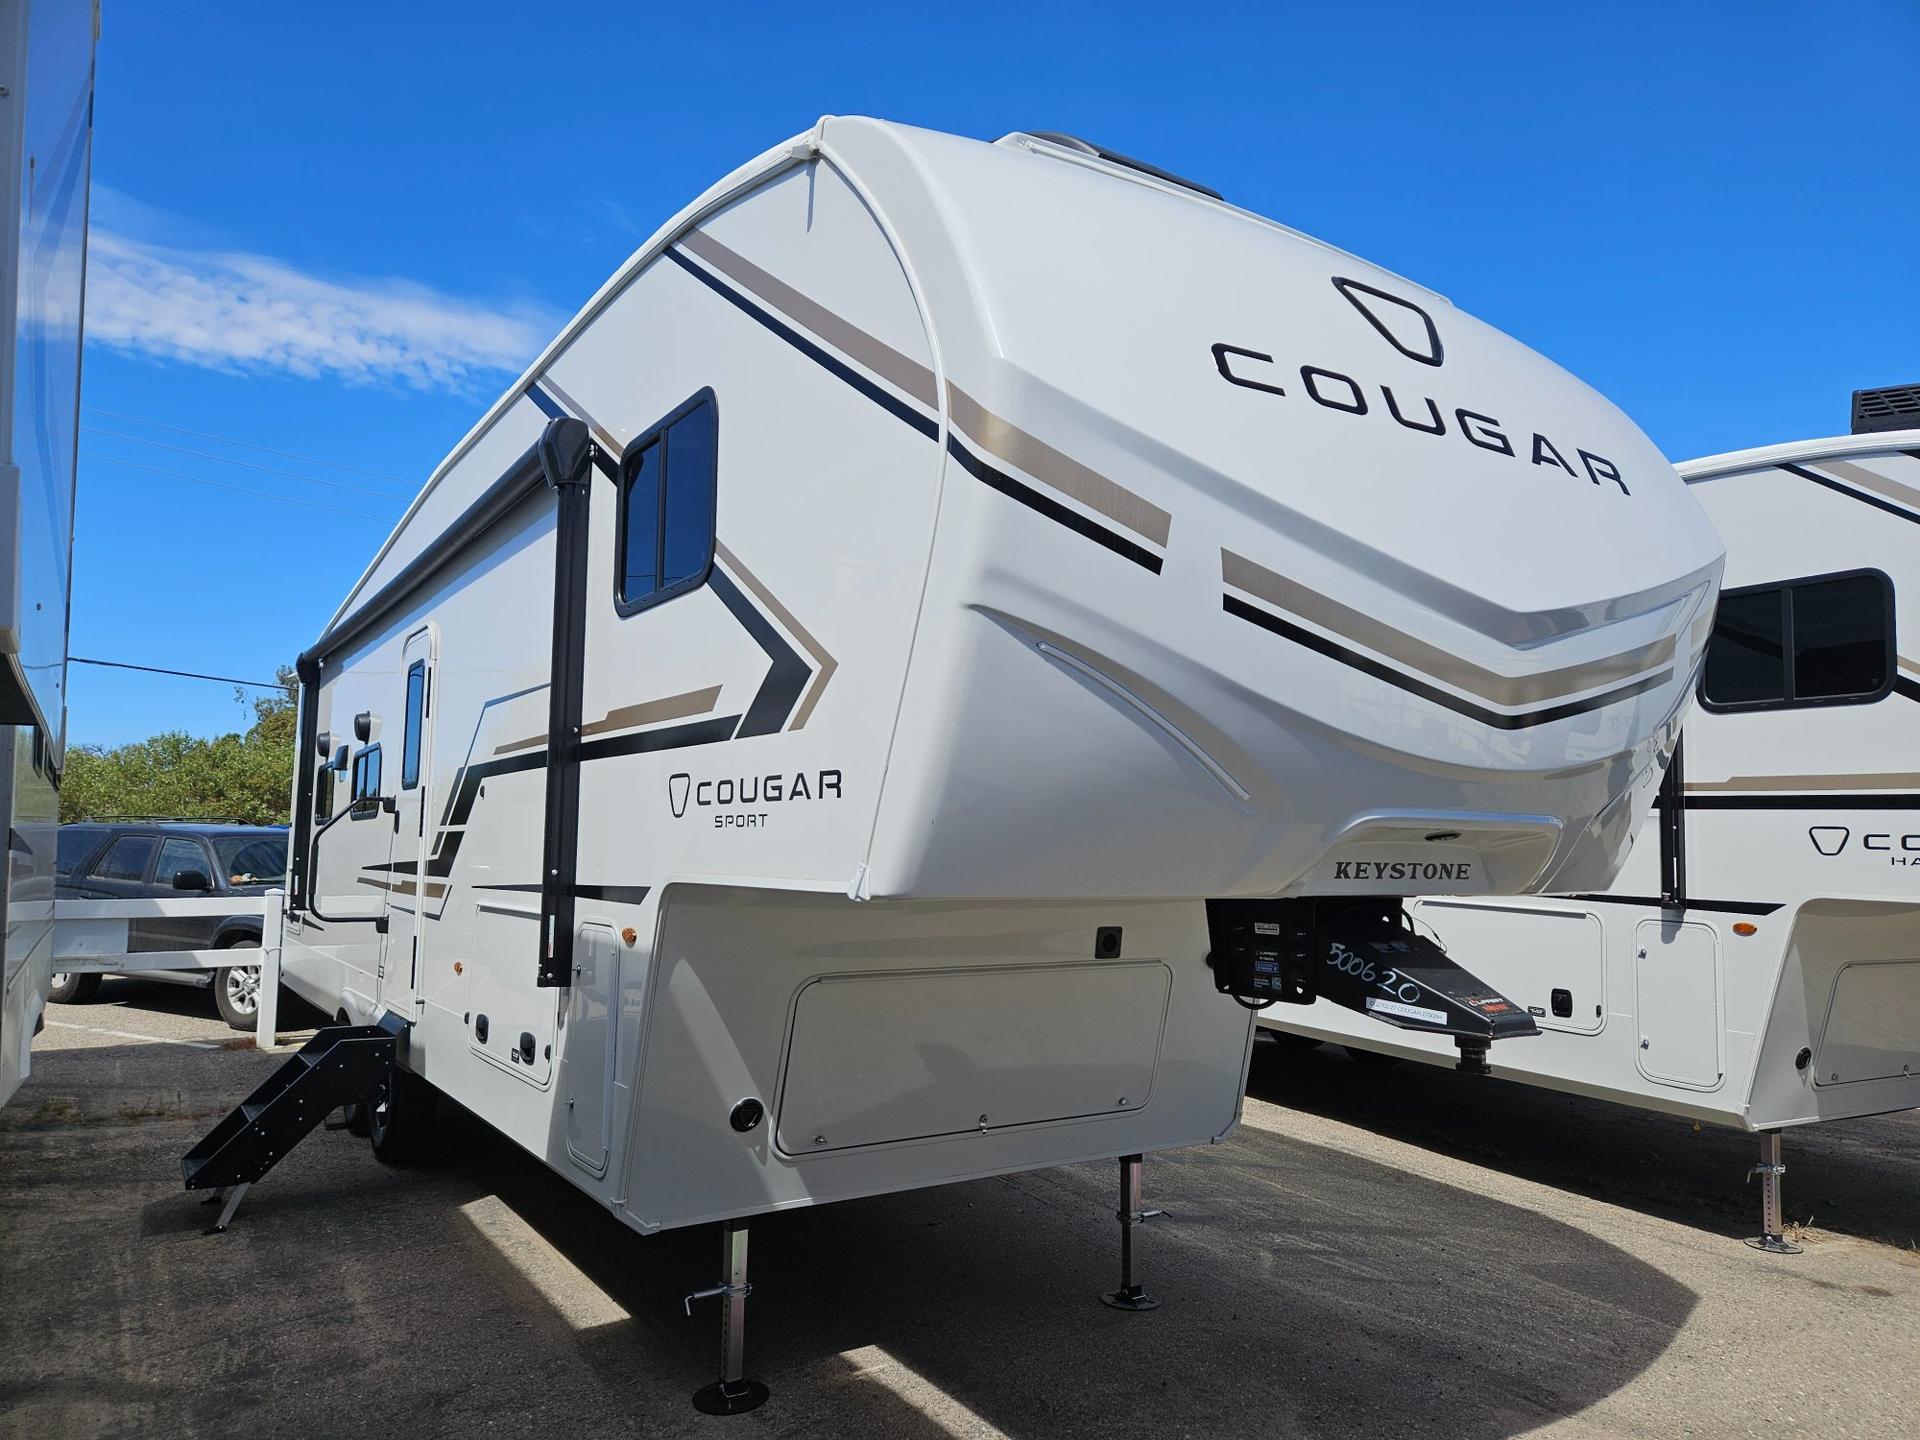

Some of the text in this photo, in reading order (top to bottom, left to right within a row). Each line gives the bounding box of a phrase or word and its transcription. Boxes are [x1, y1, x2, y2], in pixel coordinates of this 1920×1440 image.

[1211, 342, 1631, 496] COUGAR
[696, 769, 842, 806] COUGAR
[714, 813, 768, 828] SPORT
[1334, 861, 1471, 880] KEYSTONE
